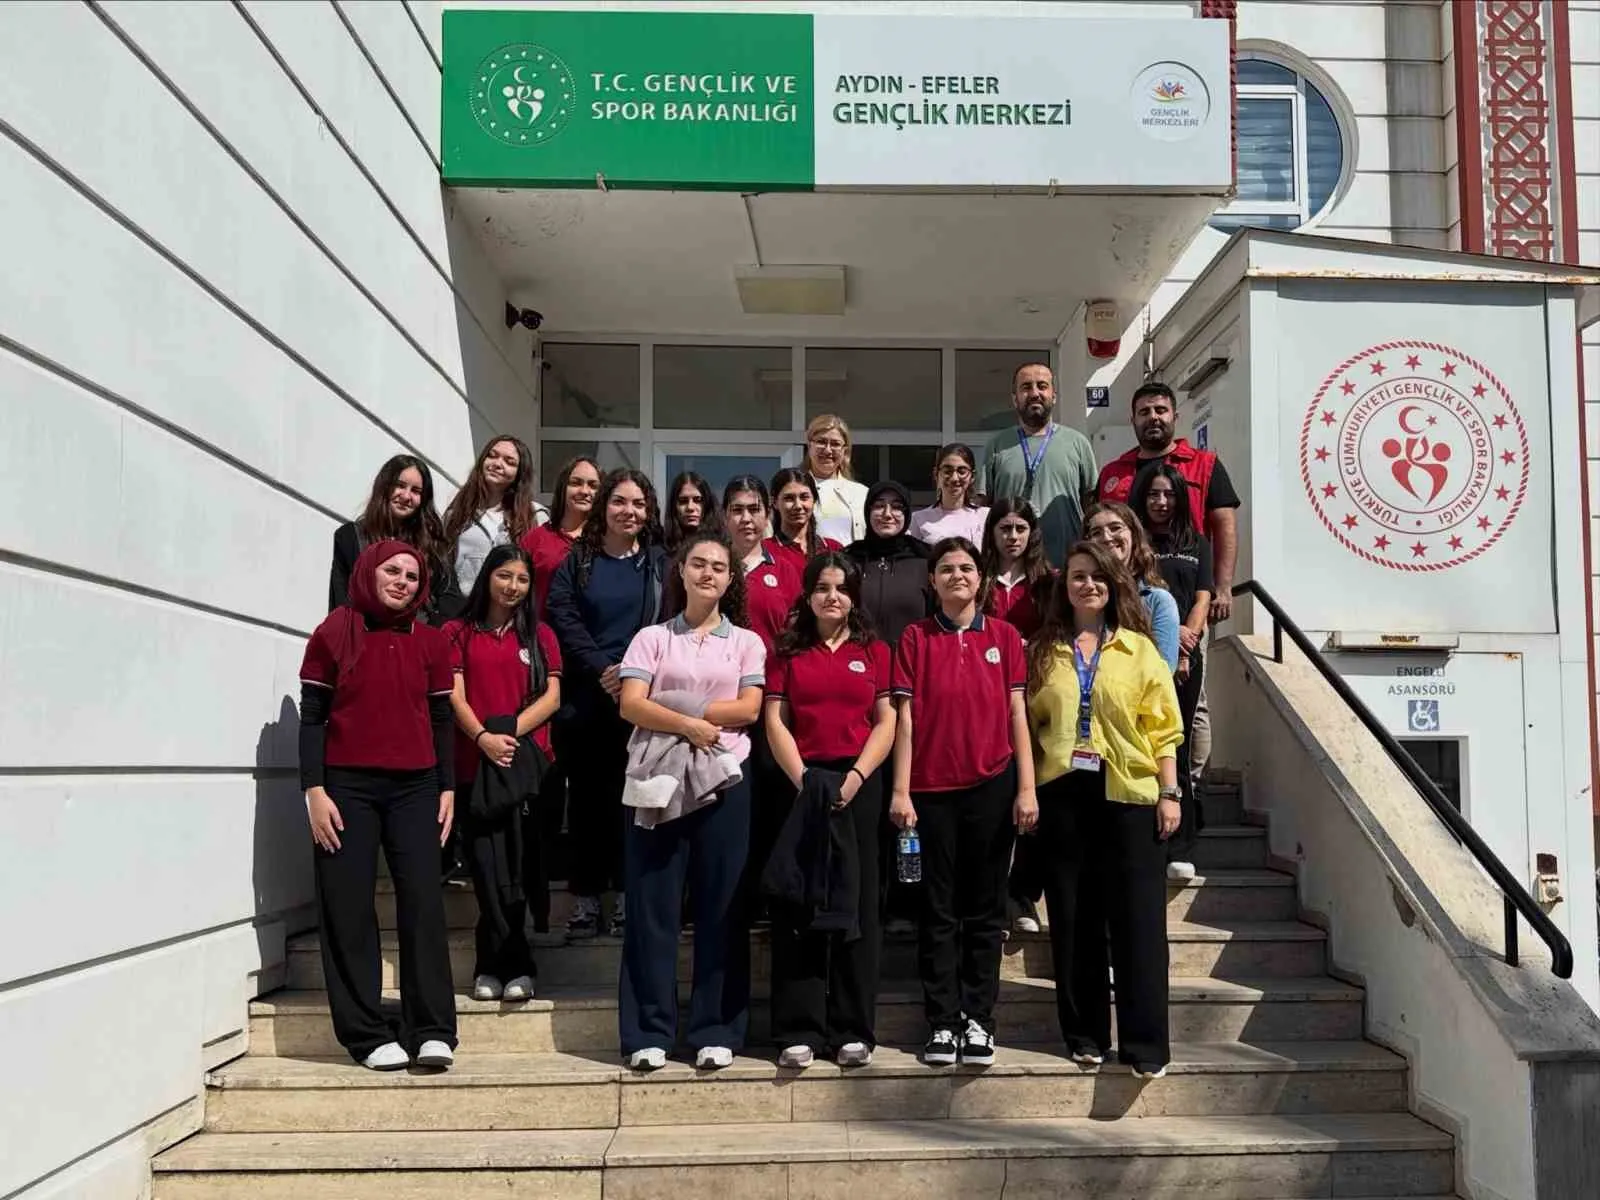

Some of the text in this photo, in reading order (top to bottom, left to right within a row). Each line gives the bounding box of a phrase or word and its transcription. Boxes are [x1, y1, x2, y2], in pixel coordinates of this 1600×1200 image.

[591, 71, 796, 98] T.C. GENÇLİK VE
[835, 75, 903, 94] AYDIN
[922, 76, 1000, 95] EFELER
[591, 100, 797, 123] SPOR BAKANLIĞI
[833, 98, 1071, 130] GENÇLİK MERKEZİ
[1091, 388, 1104, 399] 60
[1394, 383, 1455, 404] GENÇLİK
[1456, 402, 1472, 420] VE
[1344, 386, 1391, 475] CUMHURİYETİ
[1468, 420, 1488, 456] SPOR
[1439, 463, 1488, 525] BAKANLIĞI
[1387, 682, 1456, 696] ASANSÖRÜ
